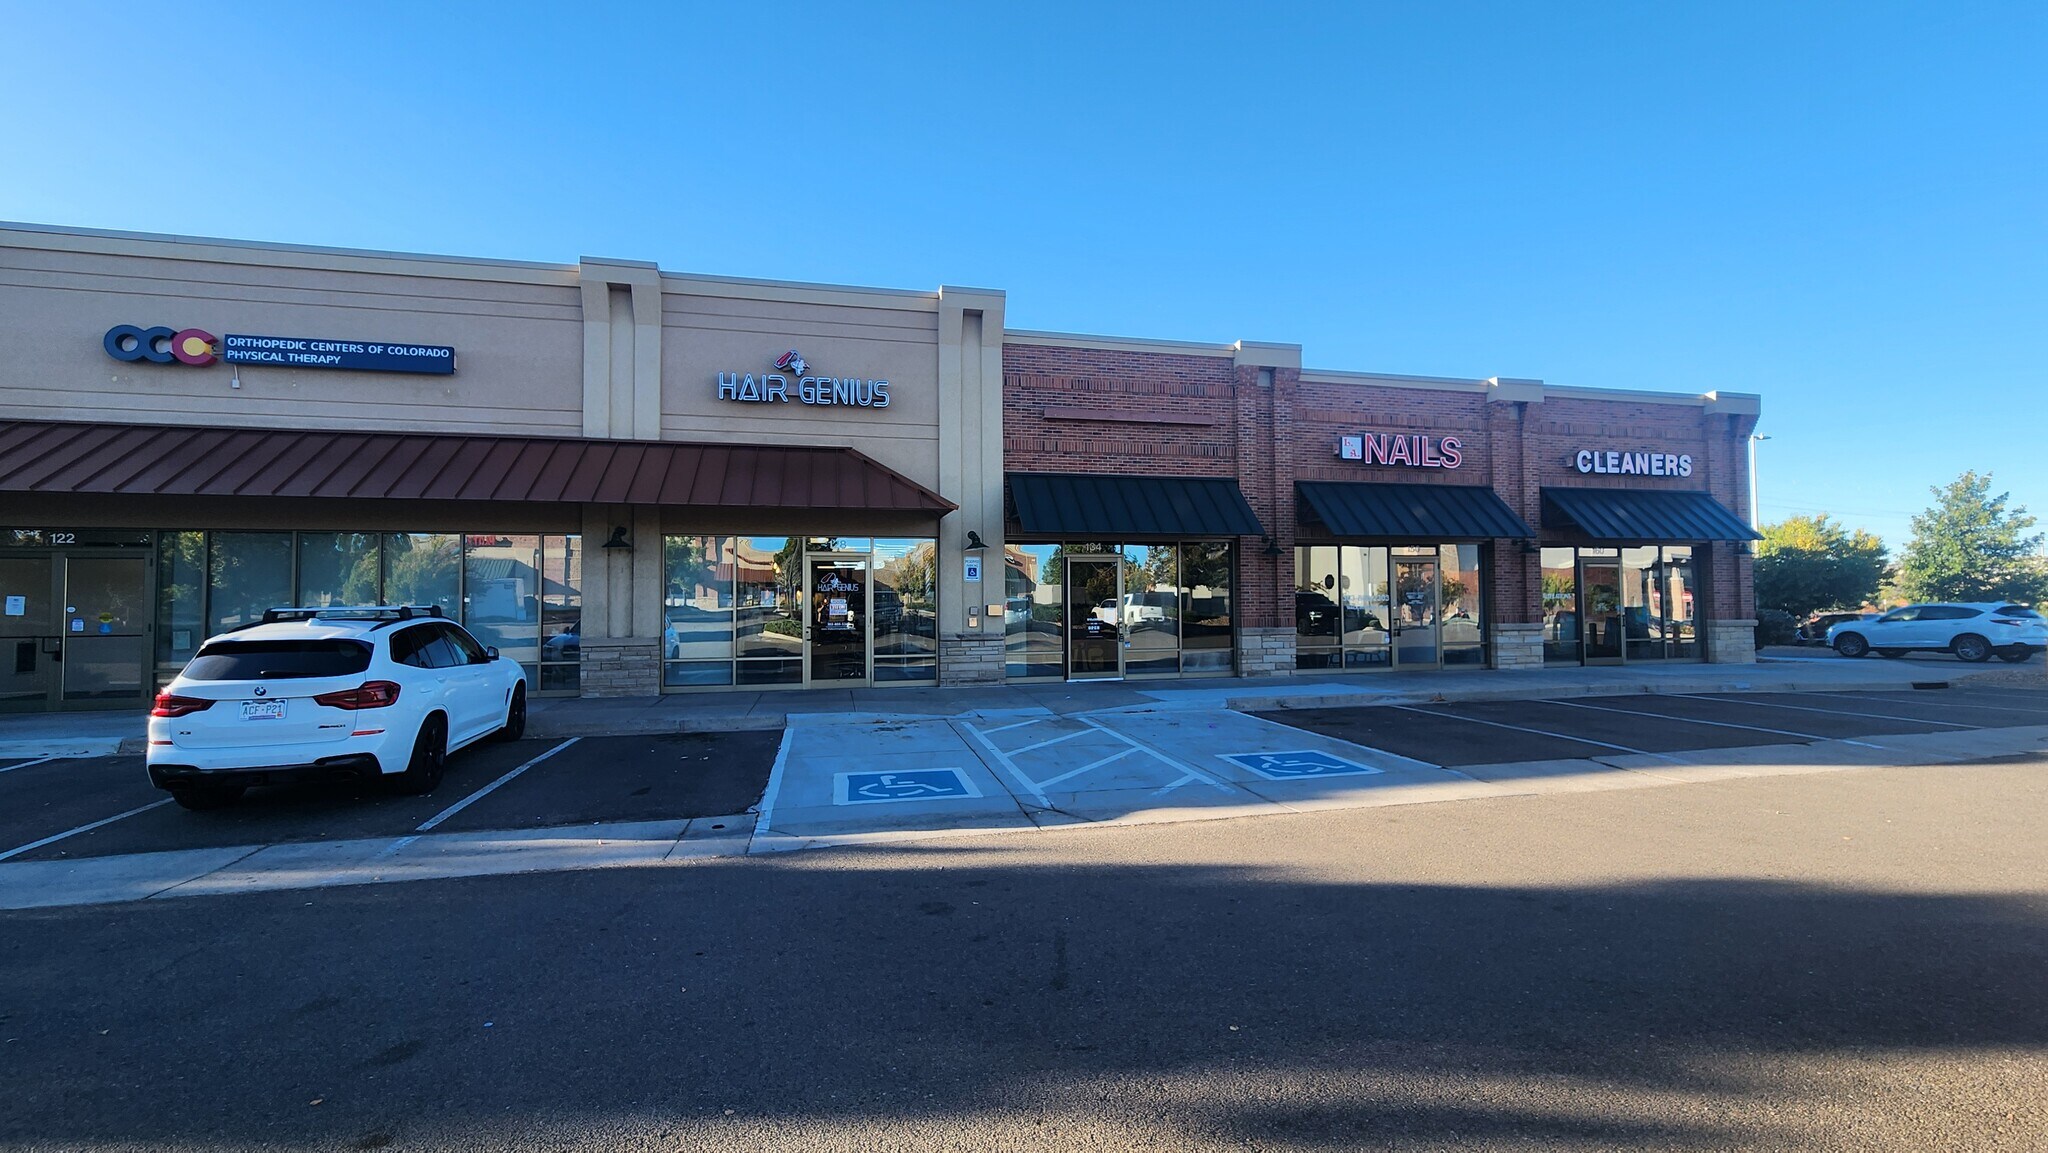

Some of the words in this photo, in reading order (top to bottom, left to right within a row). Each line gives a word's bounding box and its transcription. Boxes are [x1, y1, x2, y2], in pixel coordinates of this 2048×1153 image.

[104, 324, 219, 367] OCC
[227, 337, 306, 351] ORTHOPEDIC
[311, 342, 364, 354] CENTERS
[368, 345, 384, 355] OF
[387, 346, 450, 358] COLORADO
[227, 350, 285, 362] PHYSICAL
[289, 353, 342, 365] THERAPY
[718, 371, 788, 403] HAIR
[799, 376, 890, 408] GENIUS
[1365, 433, 1462, 469] NAILS
[1577, 449, 1692, 477] CLEANERS
[50, 533, 76, 544] 122
[1086, 542, 1102, 552] 134
[817, 583, 834, 592] HAIR
[837, 583, 859, 592] GENIUS
